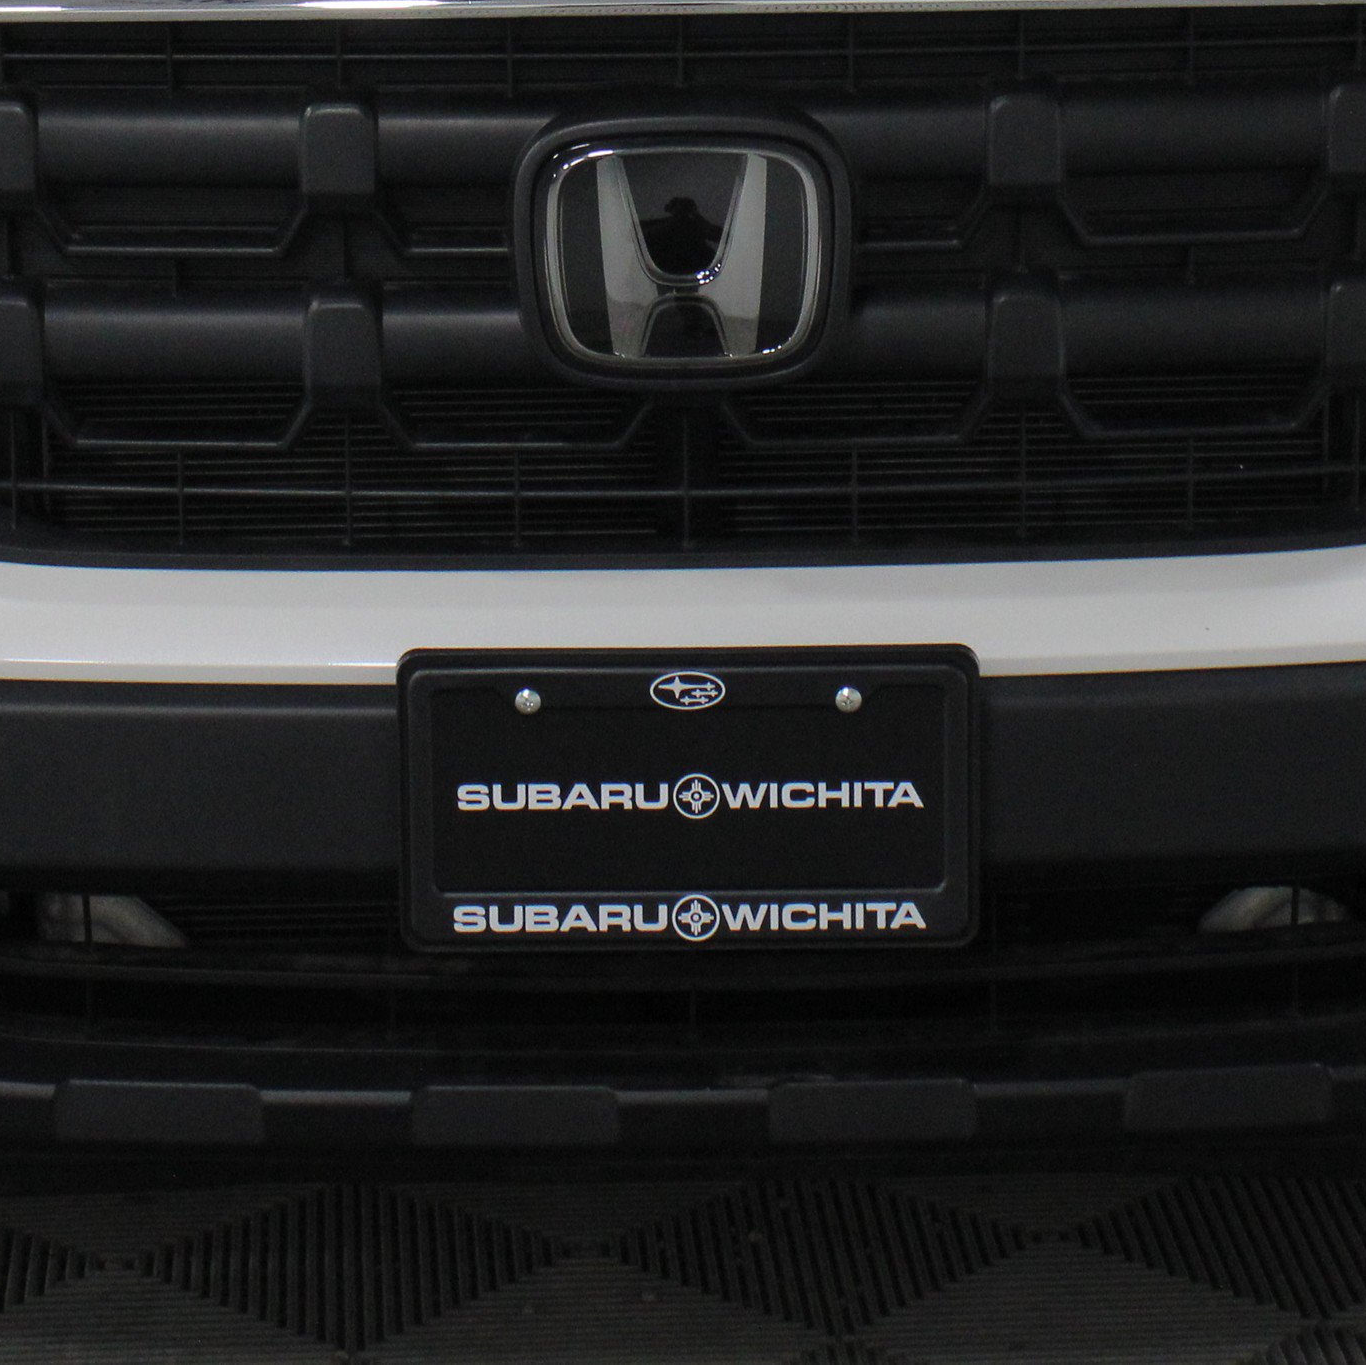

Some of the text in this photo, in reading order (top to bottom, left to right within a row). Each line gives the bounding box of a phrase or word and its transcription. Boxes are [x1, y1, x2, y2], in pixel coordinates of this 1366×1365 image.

[456, 781, 925, 812] SUBARU WICHITA
[452, 901, 928, 934] SUBARU WICHITA
